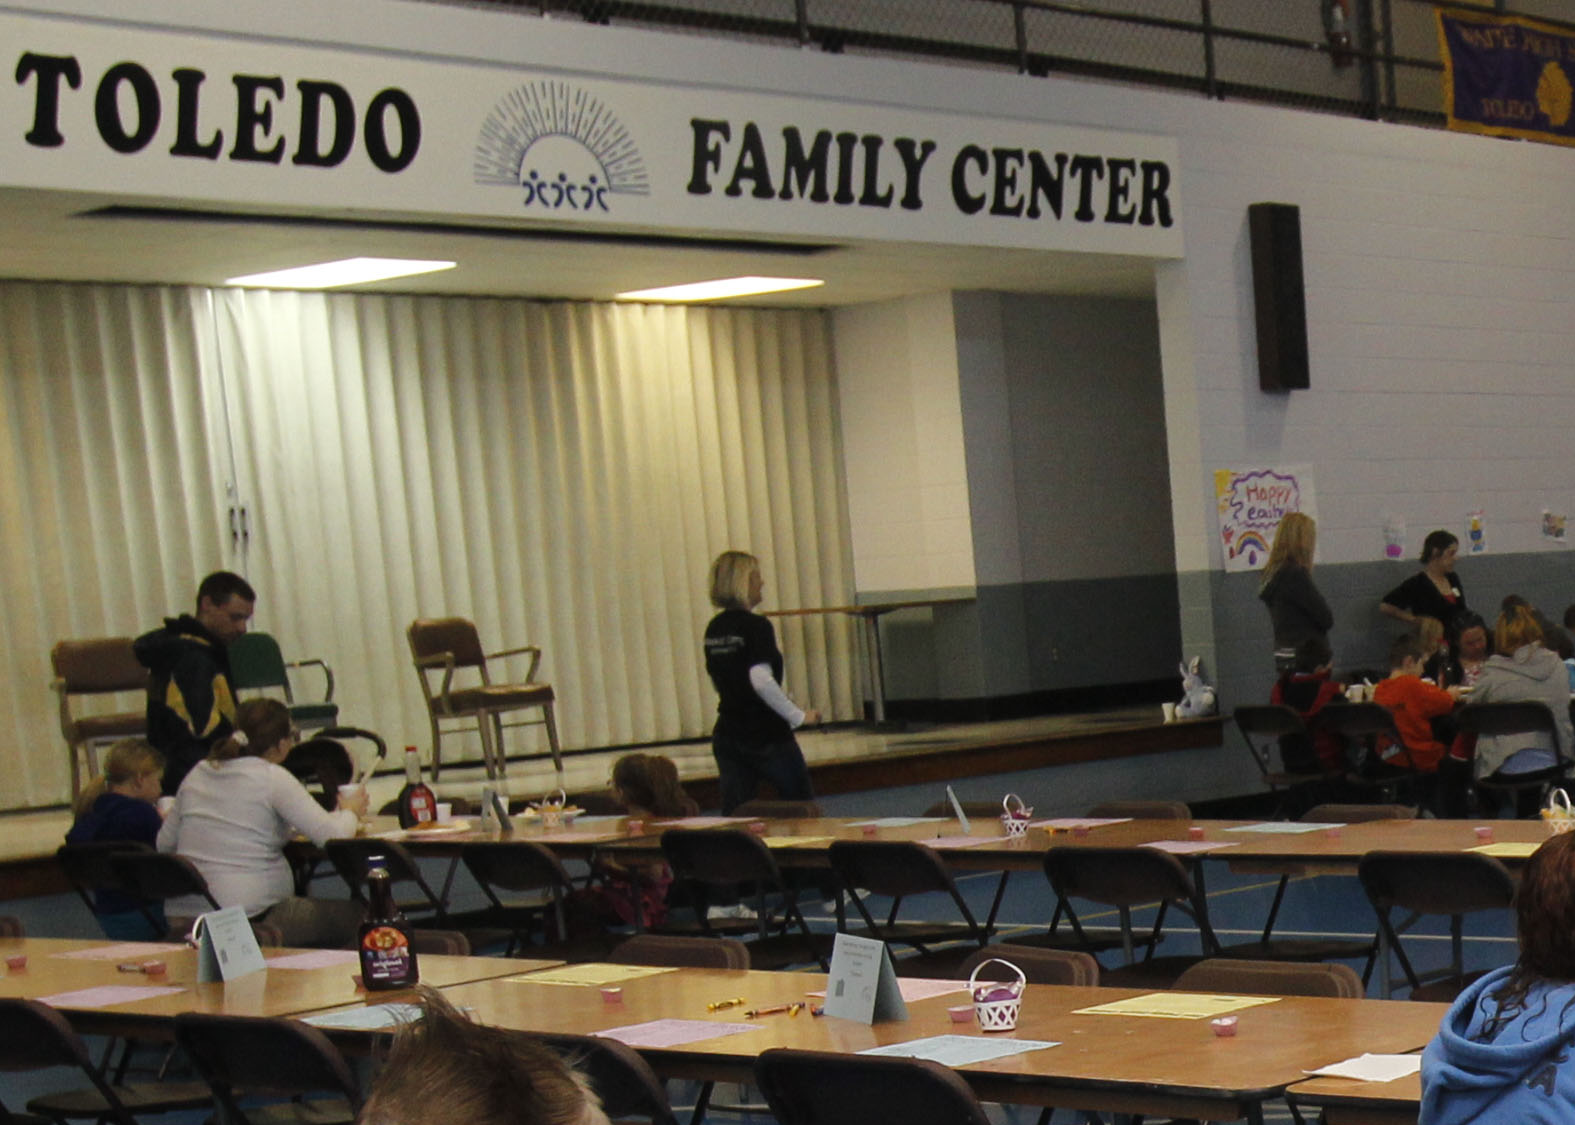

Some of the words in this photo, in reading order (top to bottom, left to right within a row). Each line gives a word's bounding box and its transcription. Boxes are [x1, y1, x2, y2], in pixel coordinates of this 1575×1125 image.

[16, 51, 422, 174] TOLEDO
[687, 117, 937, 211] FAMILY
[951, 143, 1174, 228] CENTER
